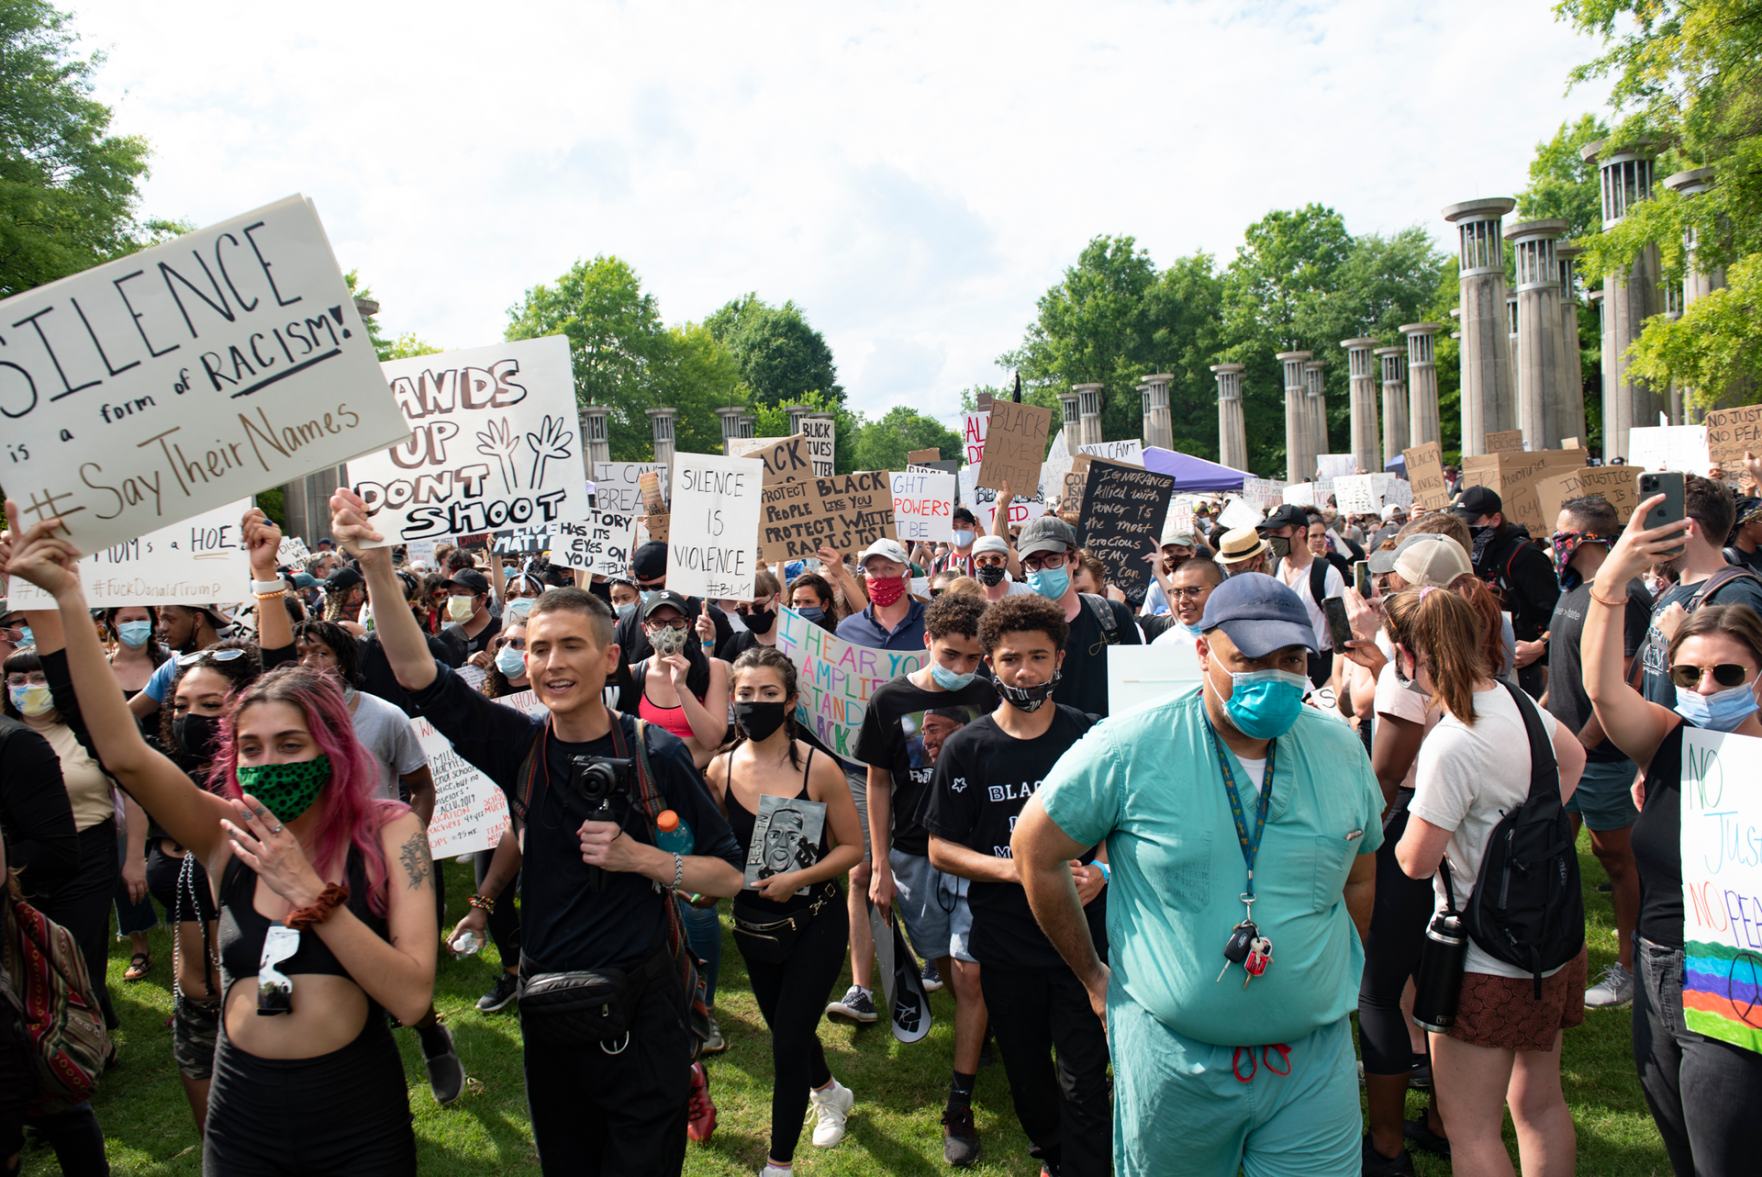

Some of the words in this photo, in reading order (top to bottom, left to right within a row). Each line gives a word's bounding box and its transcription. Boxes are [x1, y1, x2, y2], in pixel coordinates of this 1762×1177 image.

[7, 443, 30, 464] is
[59, 428, 74, 442] a
[99, 395, 157, 424] form
[173, 367, 191, 395] of
[200, 305, 353, 392] RACISM!
[390, 358, 528, 419] ANDS
[990, 402, 1046, 440] BLACK
[1708, 413, 1727, 428] NO
[1730, 408, 1762, 424] JUST
[802, 422, 831, 438] BLACK
[1709, 430, 1731, 443] NO
[1734, 424, 1762, 442] PEA
[388, 420, 460, 469] UP
[807, 441, 832, 457] IVES
[984, 432, 1043, 465] LIVES
[1487, 437, 1521, 450] POLICE
[760, 439, 807, 475] ACK
[1404, 449, 1437, 470] BLACK
[598, 464, 615, 482] I
[813, 460, 833, 477] TTER
[980, 459, 1038, 493] MATTER
[1064, 472, 1087, 486] COL
[355, 463, 490, 517] DONT
[681, 470, 745, 498] SILENCE
[761, 481, 808, 504] PROTECT
[816, 471, 887, 498] BLACK
[892, 475, 928, 494] GHT
[1092, 484, 1128, 500] Allied
[1130, 487, 1160, 502] with
[1244, 484, 1270, 494] LIVID
[1410, 475, 1443, 493] LIVES
[1559, 470, 1632, 494] INJUSTICE
[1612, 488, 1626, 503] IS
[400, 487, 567, 541] SHOOT
[765, 502, 813, 523] PEOPLE
[824, 498, 847, 512] LIKE
[848, 495, 873, 510] YOU
[893, 498, 951, 516] POWERS
[560, 522, 588, 537] HAS
[593, 528, 610, 540] ITS
[585, 510, 633, 532] TORY
[707, 508, 724, 537] IS
[764, 517, 835, 544] PROTECT
[838, 509, 895, 530] WHITE
[909, 521, 929, 537] BE
[1084, 516, 1105, 531] the
[1115, 520, 1154, 534] most
[170, 540, 181, 551] a
[571, 539, 603, 554] EYES
[607, 546, 627, 562] ON
[1083, 532, 1143, 550] ferocious
[565, 551, 594, 567] YOU
[673, 544, 745, 576] VIOLENCE
[706, 580, 751, 597] #BLM
[778, 607, 800, 644] I
[805, 623, 878, 677] HEAR
[801, 681, 865, 726] STAND
[795, 702, 851, 757] BLACK
[1689, 743, 1723, 811] NO
[430, 836, 448, 849] OPS
[747, 838, 764, 866] REST
[757, 814, 769, 830] IN
[1689, 881, 1728, 933] NO
